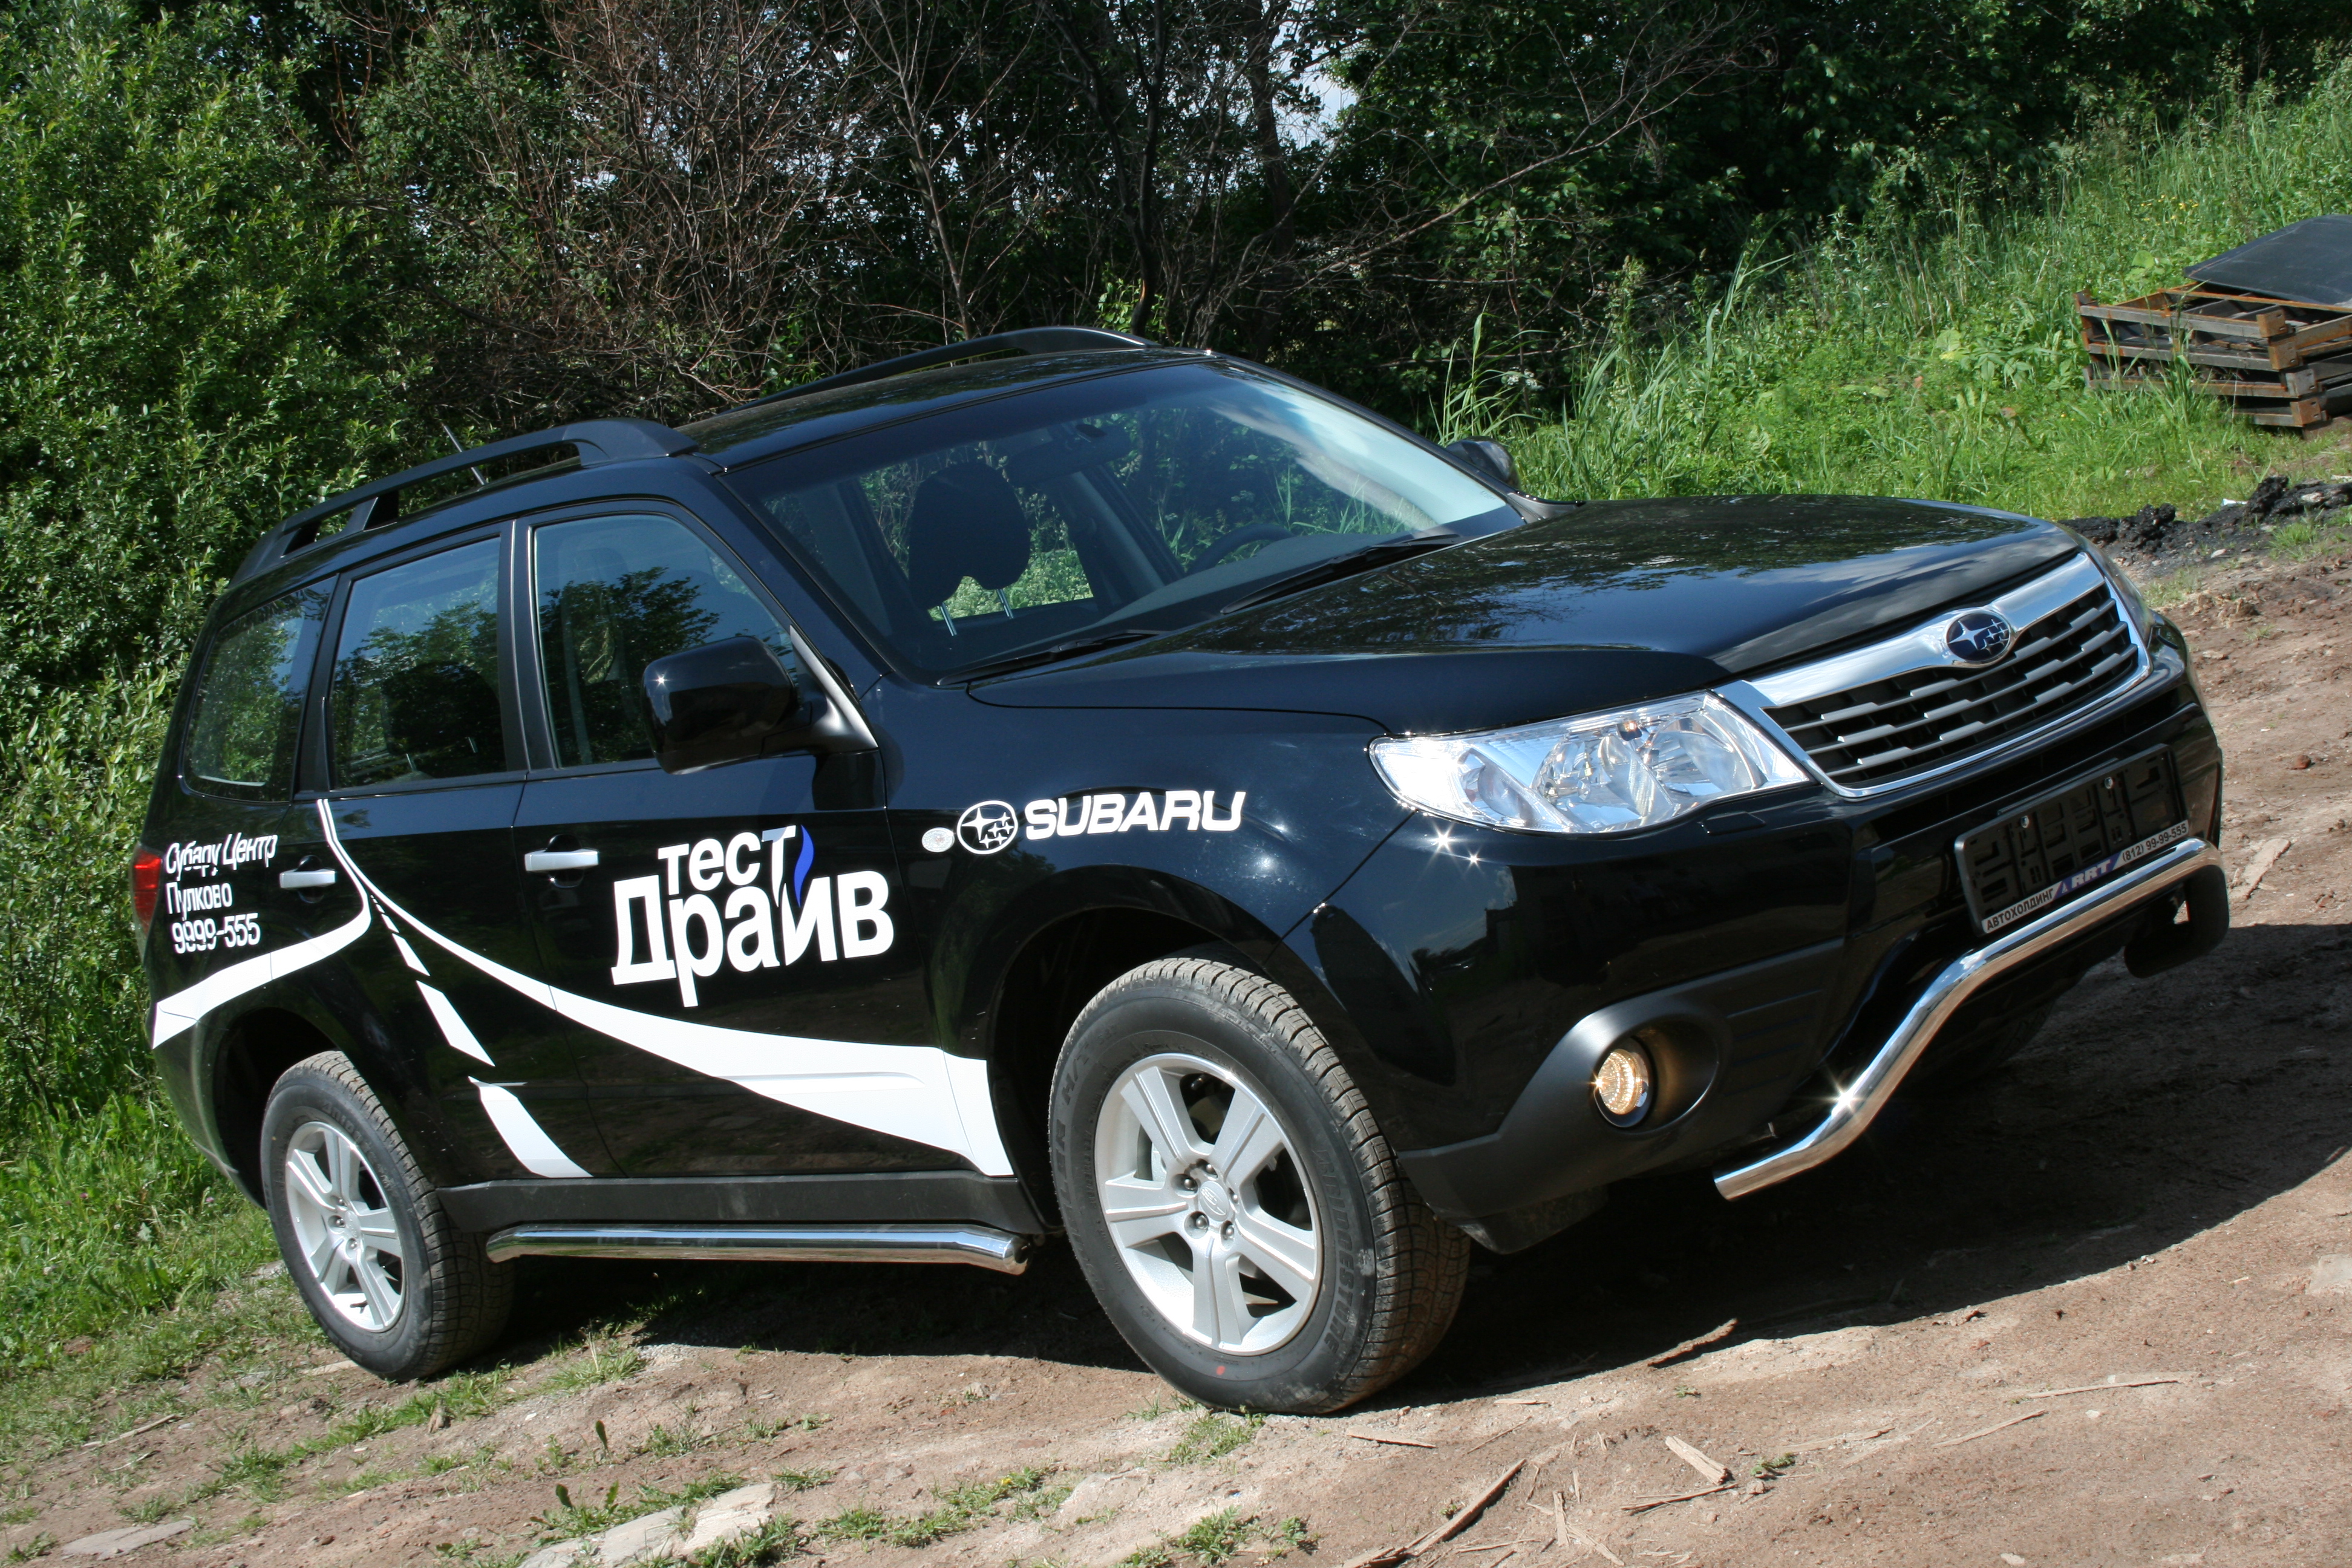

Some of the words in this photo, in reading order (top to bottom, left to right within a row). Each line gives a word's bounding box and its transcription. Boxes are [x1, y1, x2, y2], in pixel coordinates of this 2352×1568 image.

[1025, 789, 1246, 840] SUBARU
[165, 840, 222, 881] Субару
[222, 832, 278, 871] Центр
[1986, 887, 2054, 930] АВТОХОЛДИНГ
[2071, 859, 2111, 889] RRT
[2122, 843, 2145, 862] (812)
[2145, 823, 2187, 851] 99-99-555
[165, 881, 233, 921] Пулково
[171, 912, 261, 954] 9999-555
